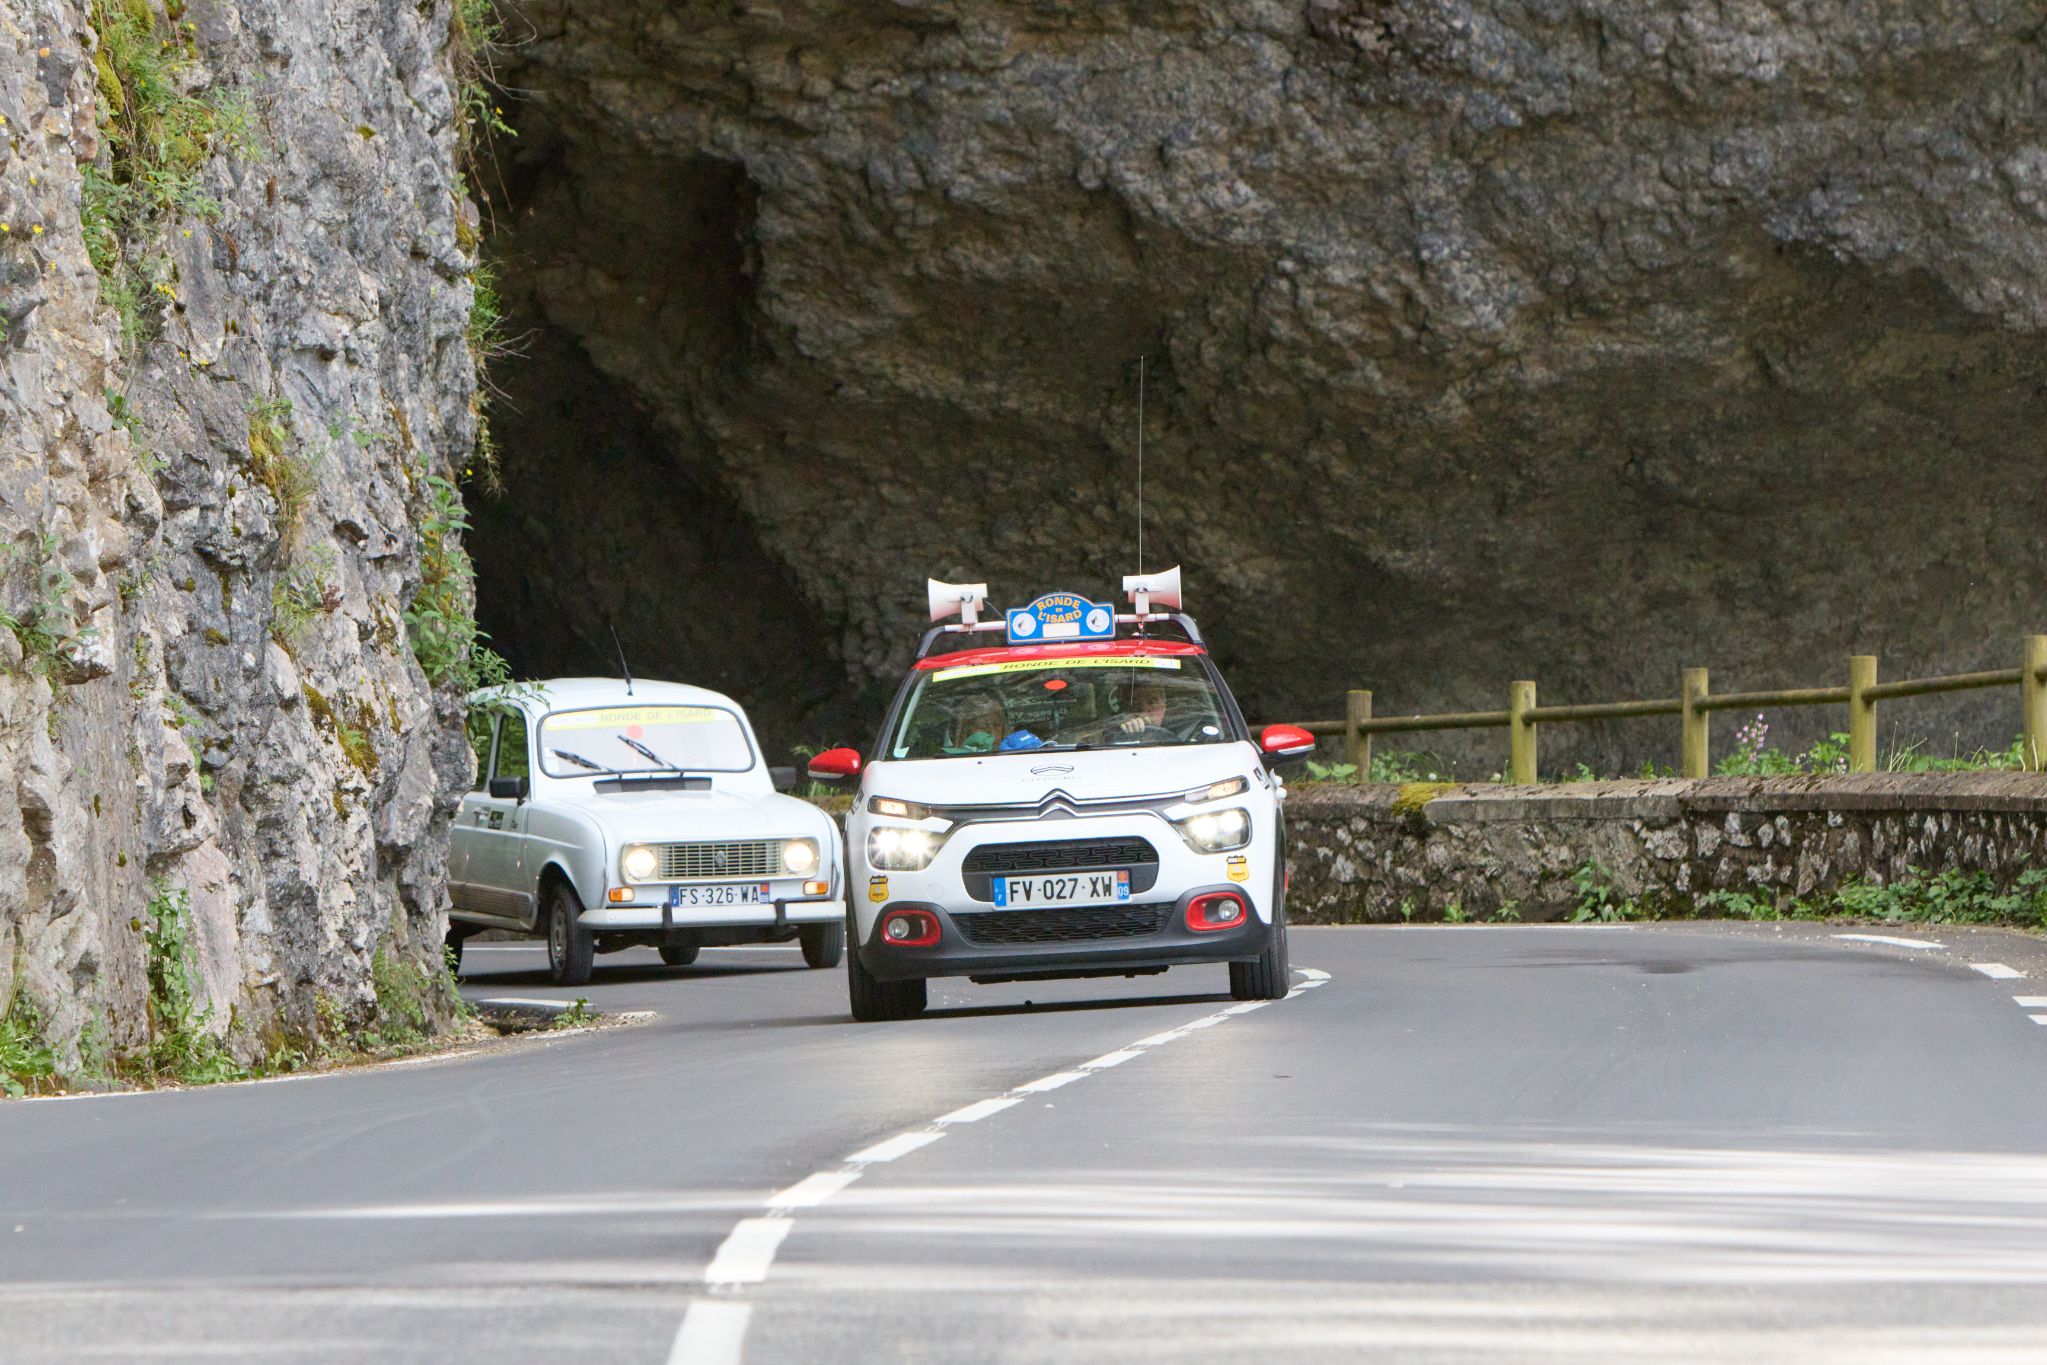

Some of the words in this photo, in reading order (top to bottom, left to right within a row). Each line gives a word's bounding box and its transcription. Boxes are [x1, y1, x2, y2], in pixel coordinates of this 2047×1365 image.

[1036, 597, 1080, 611] RONDE
[1037, 609, 1083, 623] L'ISARD
[1003, 660, 1058, 669] RONDE
[600, 711, 642, 723] RONDE
[646, 710, 663, 720] DE
[668, 708, 712, 719] L'ISARD
[1118, 886, 1129, 896] 09
